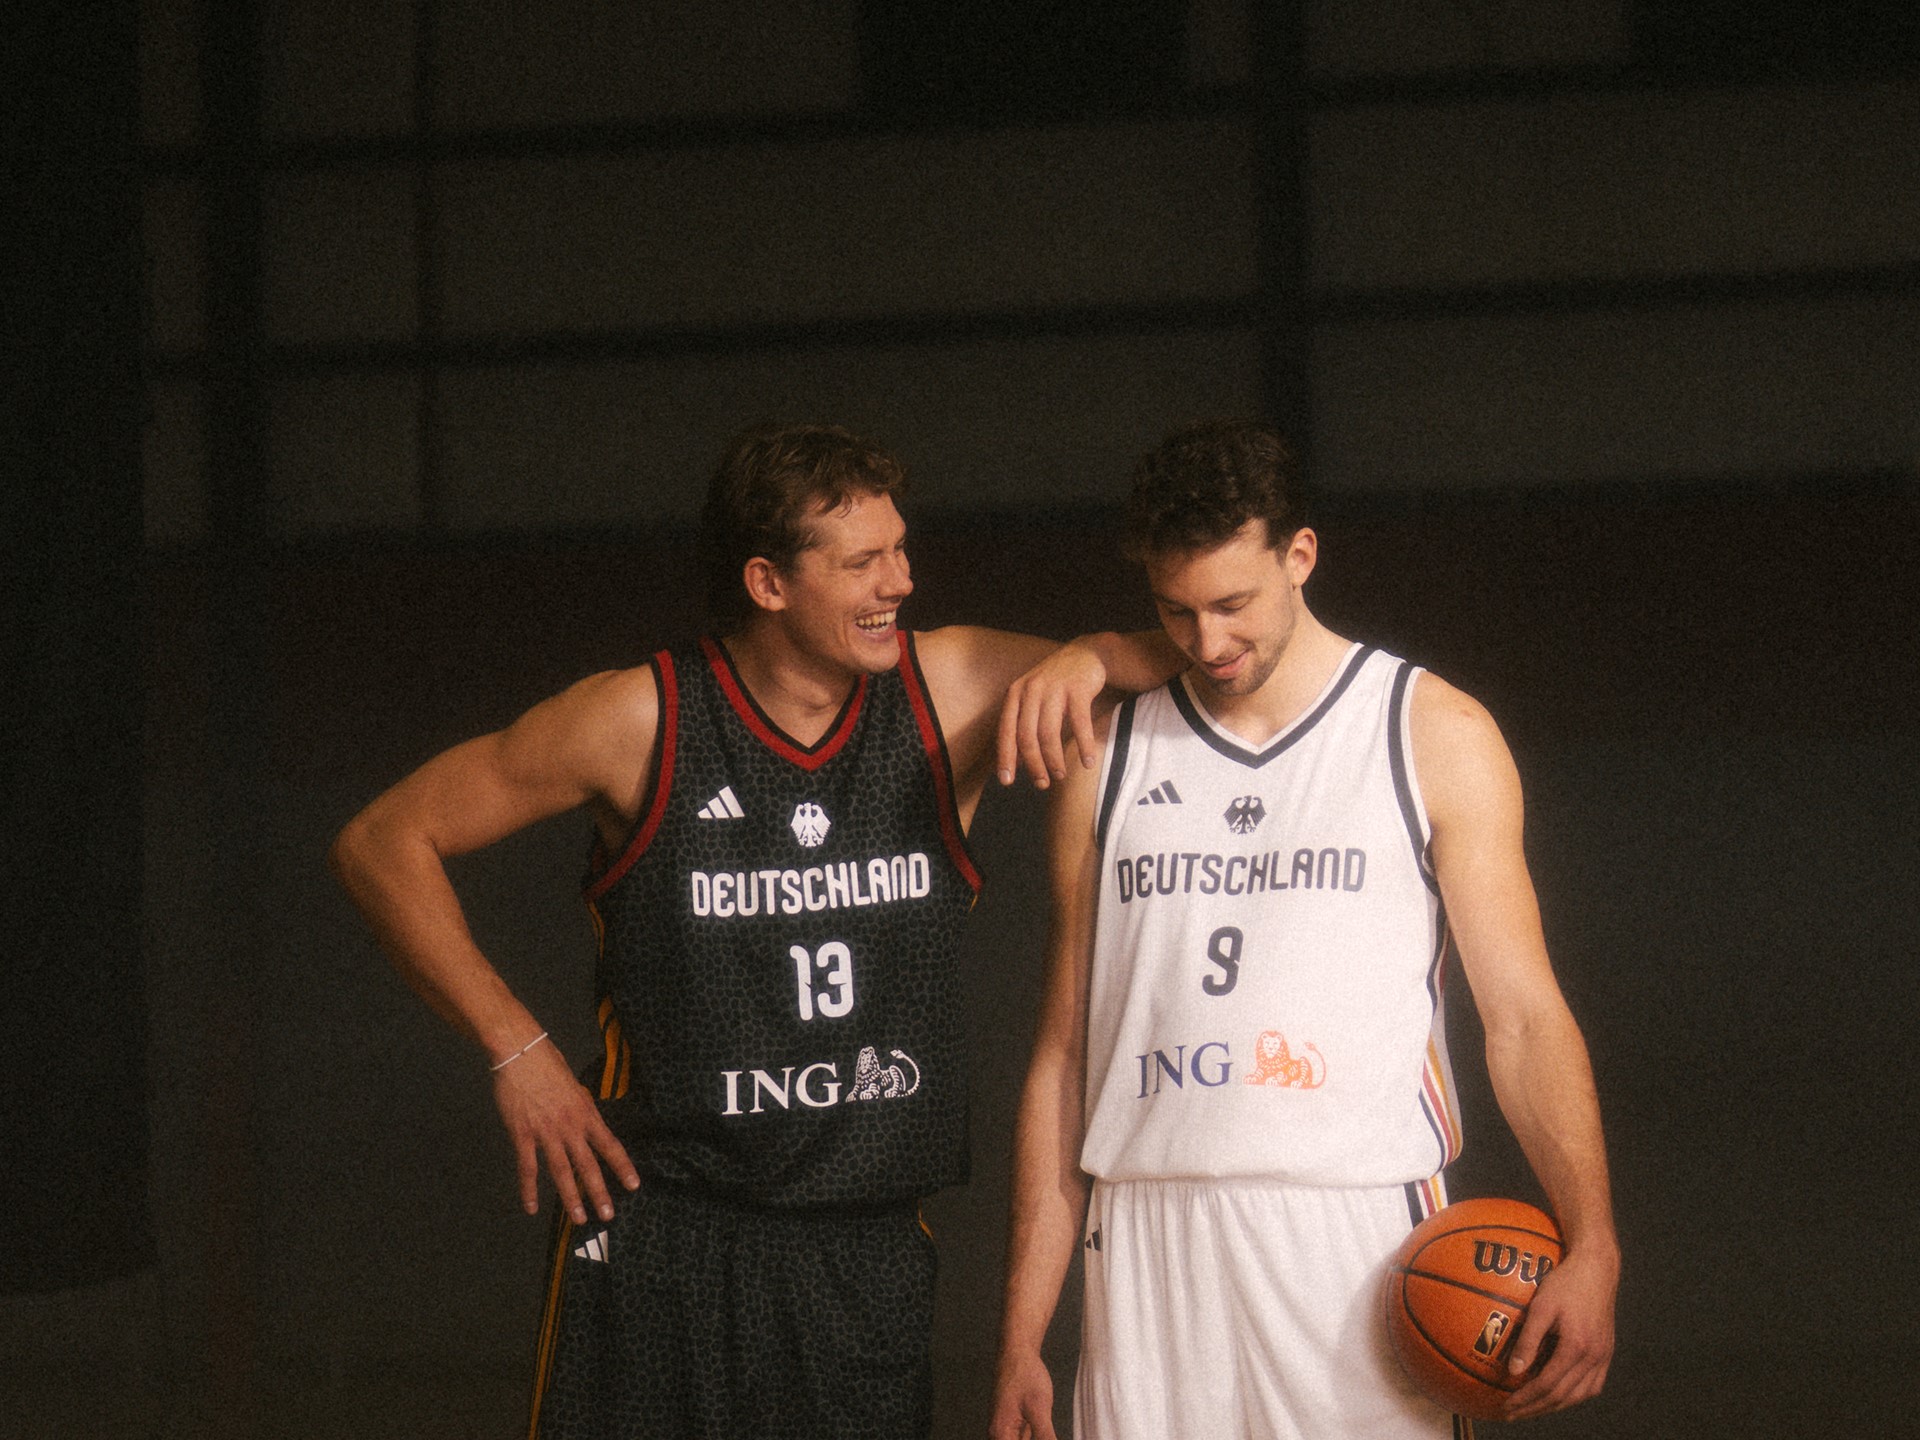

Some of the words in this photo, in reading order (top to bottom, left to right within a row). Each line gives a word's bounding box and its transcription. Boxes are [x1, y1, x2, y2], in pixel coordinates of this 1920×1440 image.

[691, 852, 931, 917] DEUTSCHLAND
[1117, 847, 1367, 904] DEUTSCHLAND
[789, 941, 854, 1021] 13
[1202, 926, 1244, 997] 9
[720, 1062, 843, 1115] ING
[1136, 1041, 1234, 1099] ING
